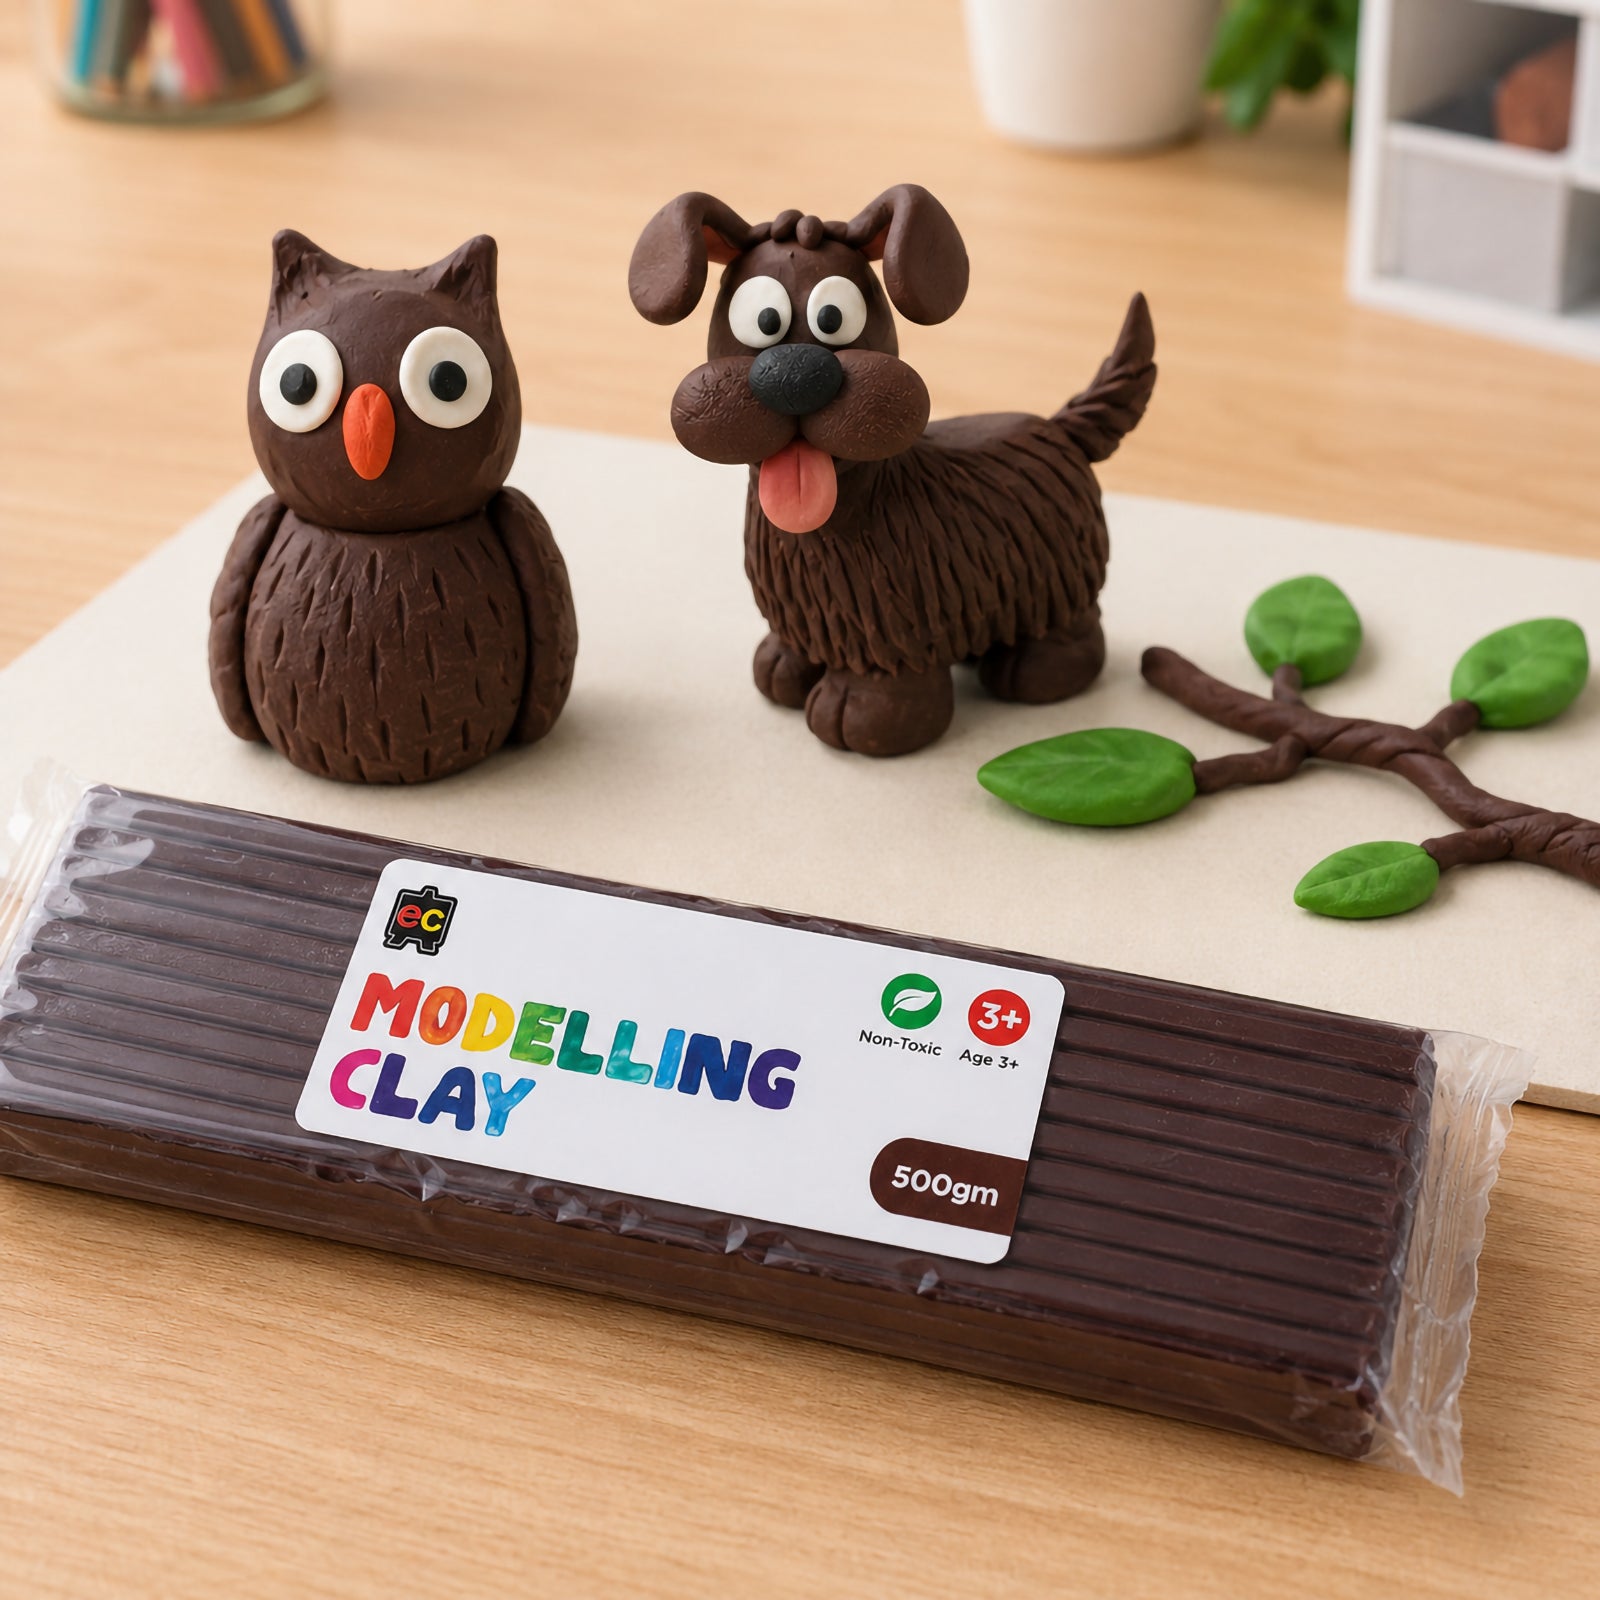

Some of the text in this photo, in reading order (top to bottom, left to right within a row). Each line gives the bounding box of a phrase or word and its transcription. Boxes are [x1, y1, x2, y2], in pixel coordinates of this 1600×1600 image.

[397, 904, 445, 932] ec
[977, 1001, 1022, 1029] 3+
[350, 973, 802, 1110] MODELLING
[858, 1030, 943, 1056] Non-Toxic
[958, 1049, 1020, 1069] Age 3+
[330, 1048, 536, 1137] CLAY
[891, 1164, 999, 1207] 500gm
